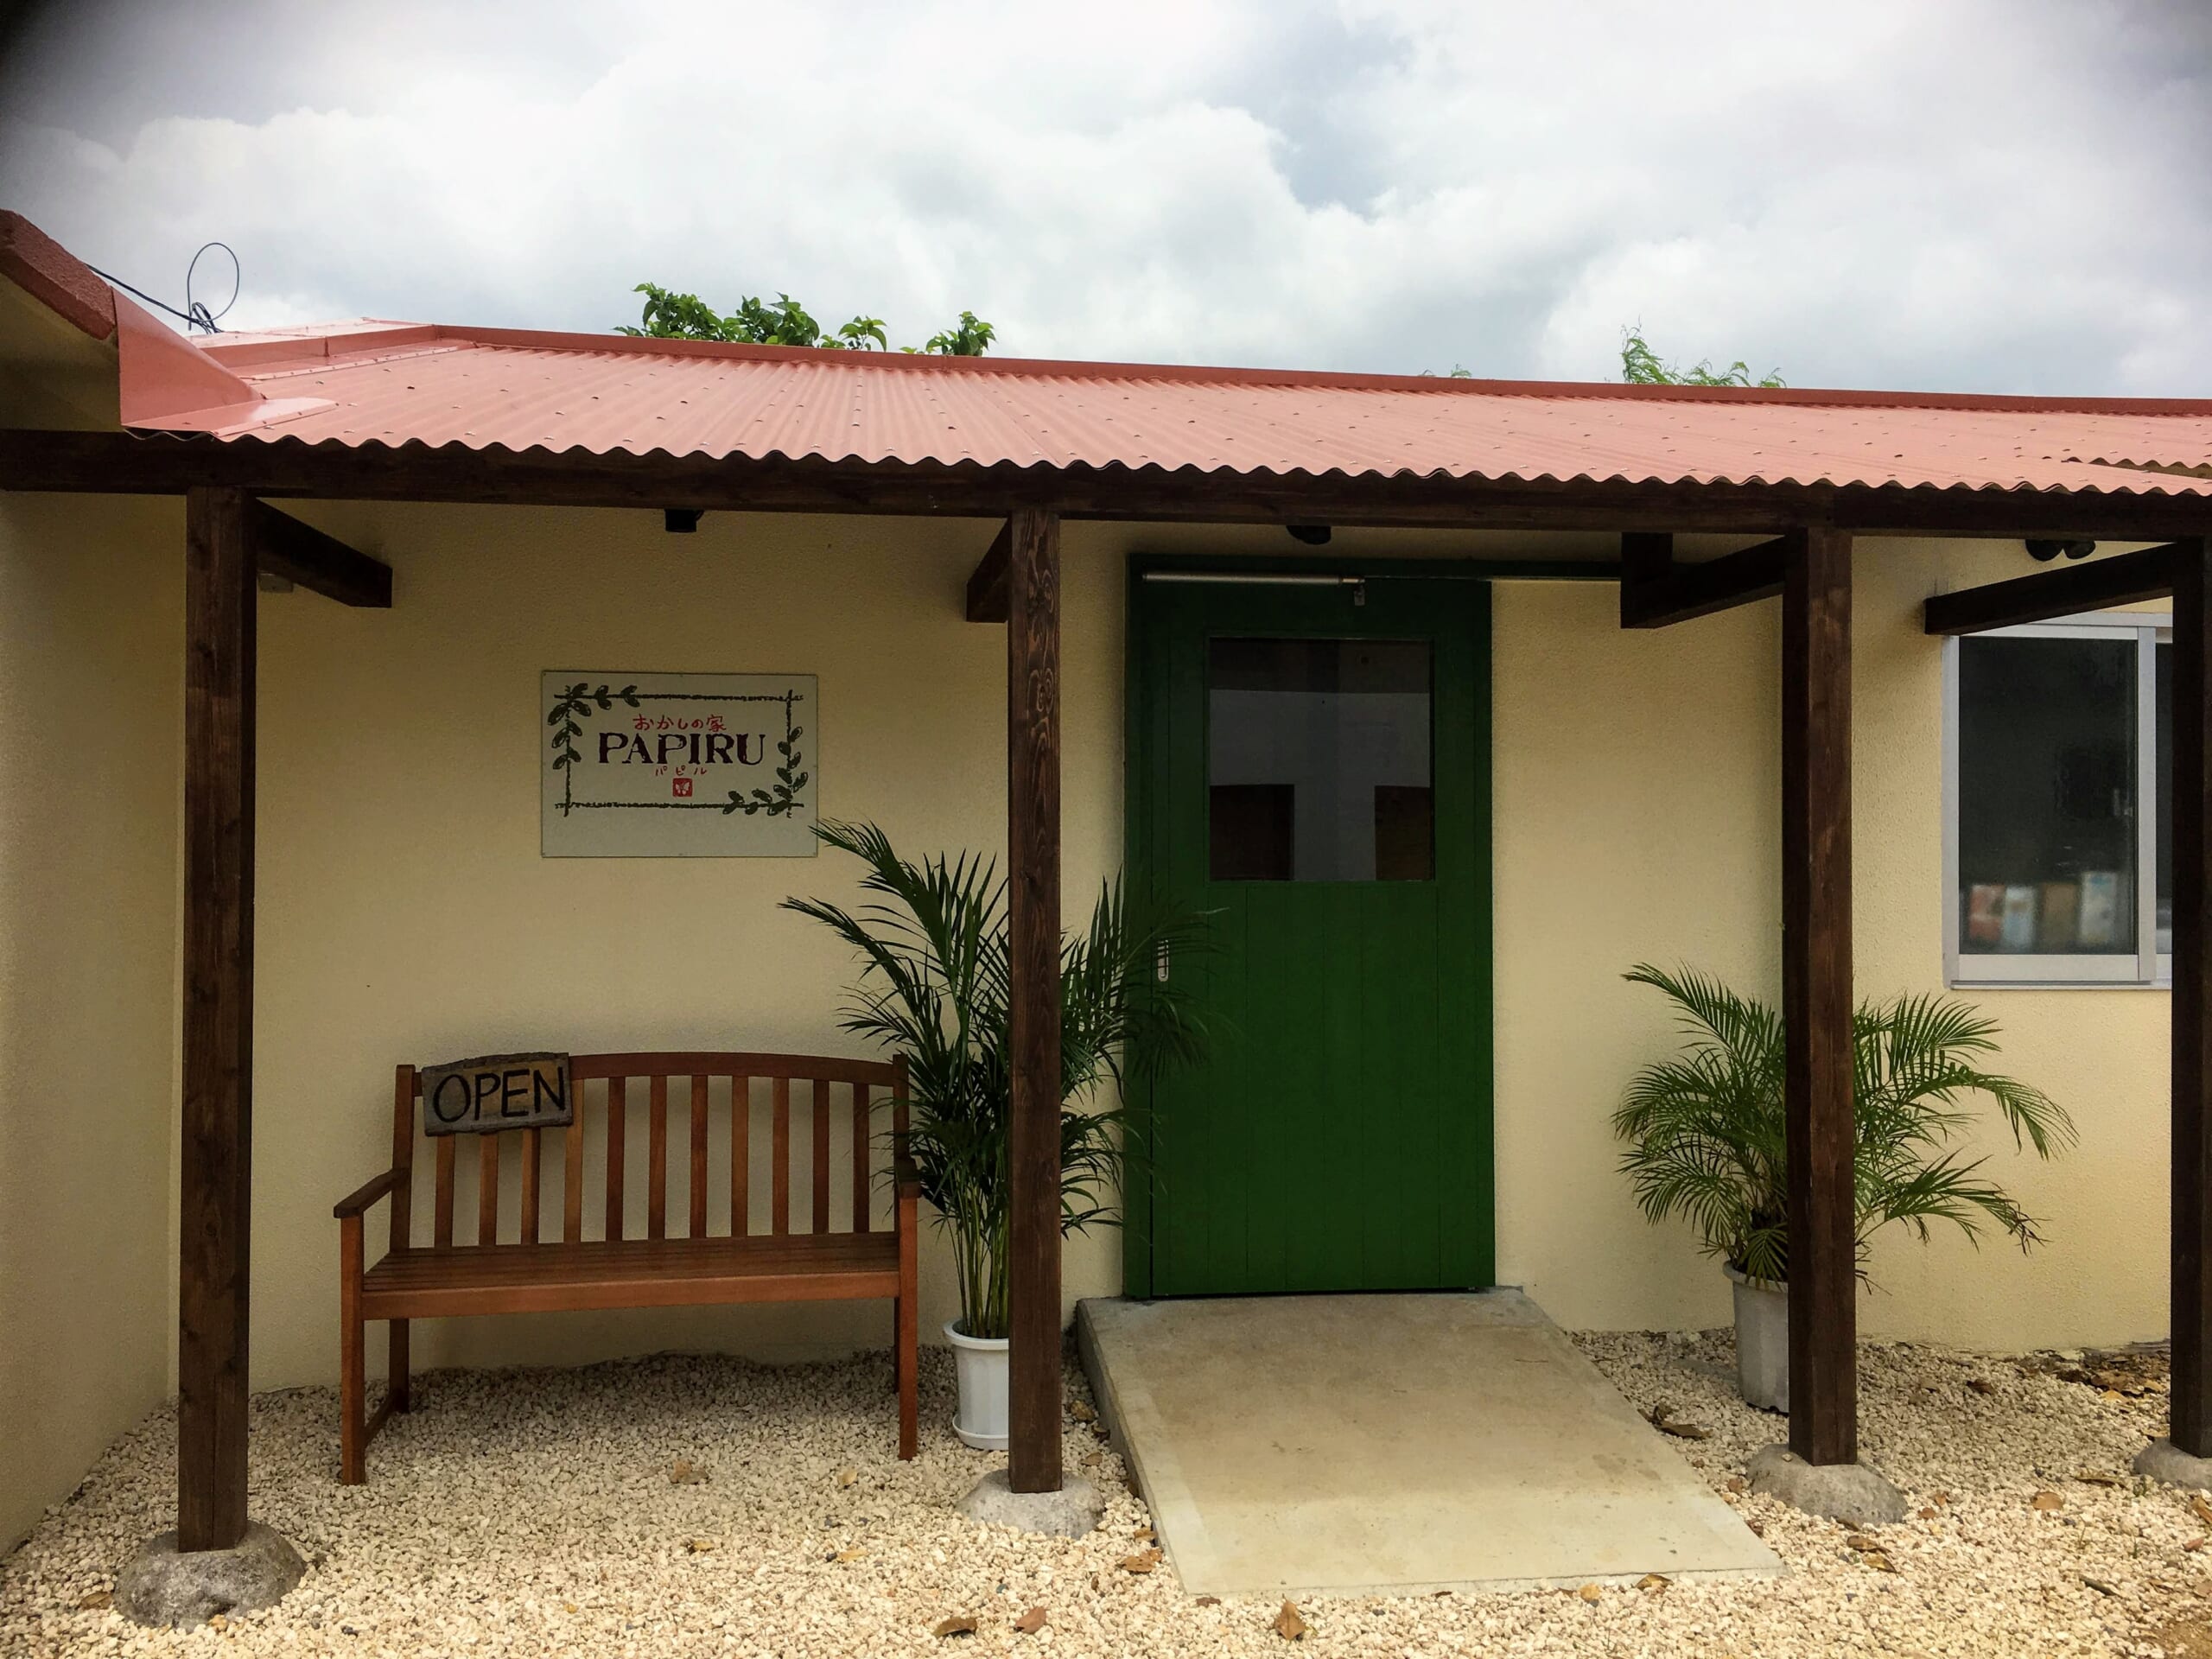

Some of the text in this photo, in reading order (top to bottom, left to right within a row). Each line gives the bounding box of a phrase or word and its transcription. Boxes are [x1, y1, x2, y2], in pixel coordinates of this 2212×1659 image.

[632, 714, 727, 732] おかしの家
[598, 732, 766, 766] PAPIRU
[654, 766, 708, 777] パピル
[433, 1066, 566, 1122] OPEN
